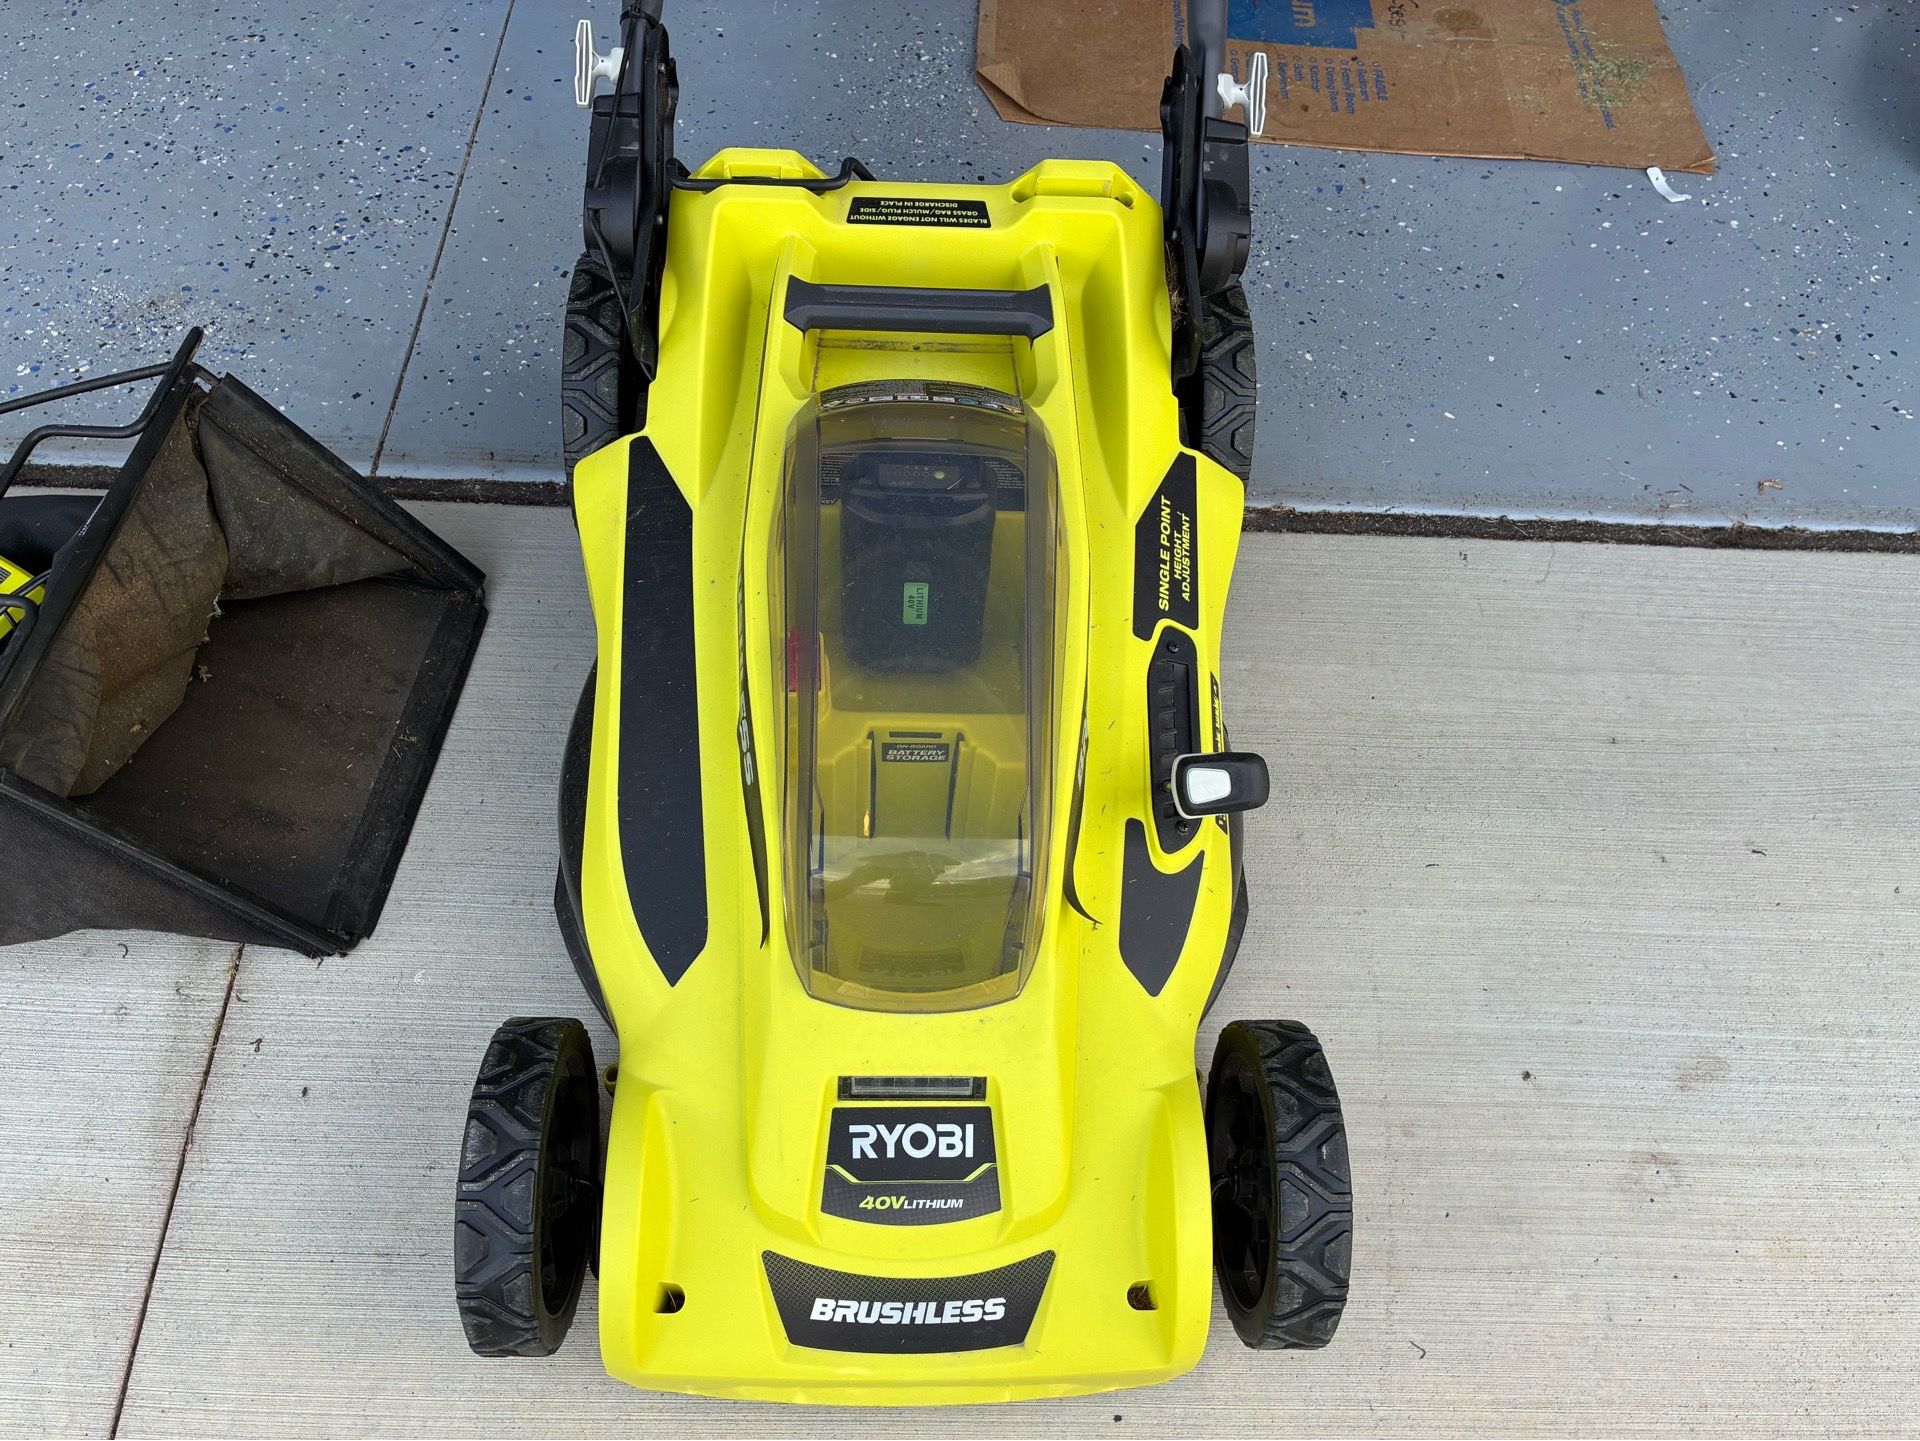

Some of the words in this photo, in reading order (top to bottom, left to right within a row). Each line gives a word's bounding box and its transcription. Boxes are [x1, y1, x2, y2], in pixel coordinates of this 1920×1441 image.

[1325, 67, 1336, 91] Dining
[1341, 68, 1353, 91] Family
[1375, 69, 1388, 101] FRAGILE
[1328, 90, 1339, 112] Room
[1345, 91, 1355, 114] Room
[1160, 494, 1171, 547] POINT
[1174, 530, 1182, 580] HEIGHT
[1182, 512, 1190, 602] ADJUSTMENT
[1158, 548, 1170, 612] SINGLE
[907, 595, 915, 609] 40V
[916, 587, 924, 619] LITHIUM
[849, 1123, 973, 1160] RYOBI
[810, 1297, 1006, 1325] BRUSHLESS
